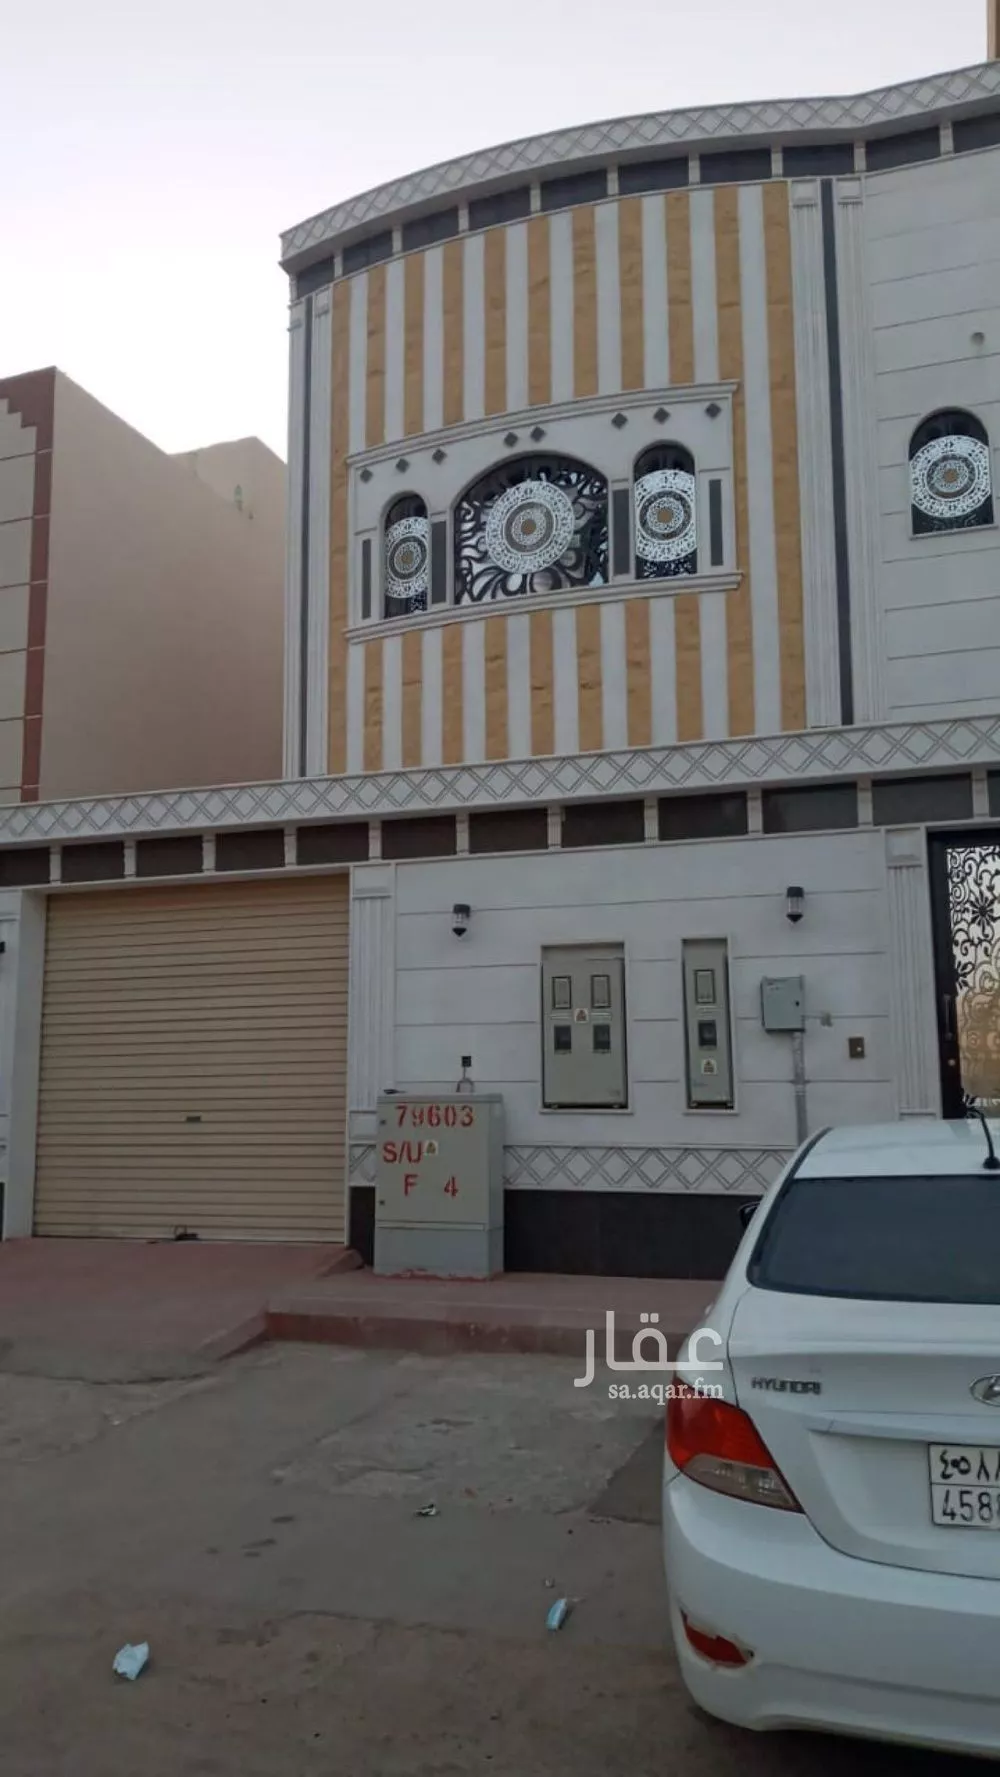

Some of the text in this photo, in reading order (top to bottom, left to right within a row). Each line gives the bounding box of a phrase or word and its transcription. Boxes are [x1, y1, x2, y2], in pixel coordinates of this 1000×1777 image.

[395, 1102, 474, 1128] 79603
[383, 1141, 423, 1164] S/U
[404, 1173, 459, 1198] F 4
[751, 1377, 821, 1395] HYUNDAI
[942, 1489, 1000, 1523] 458
